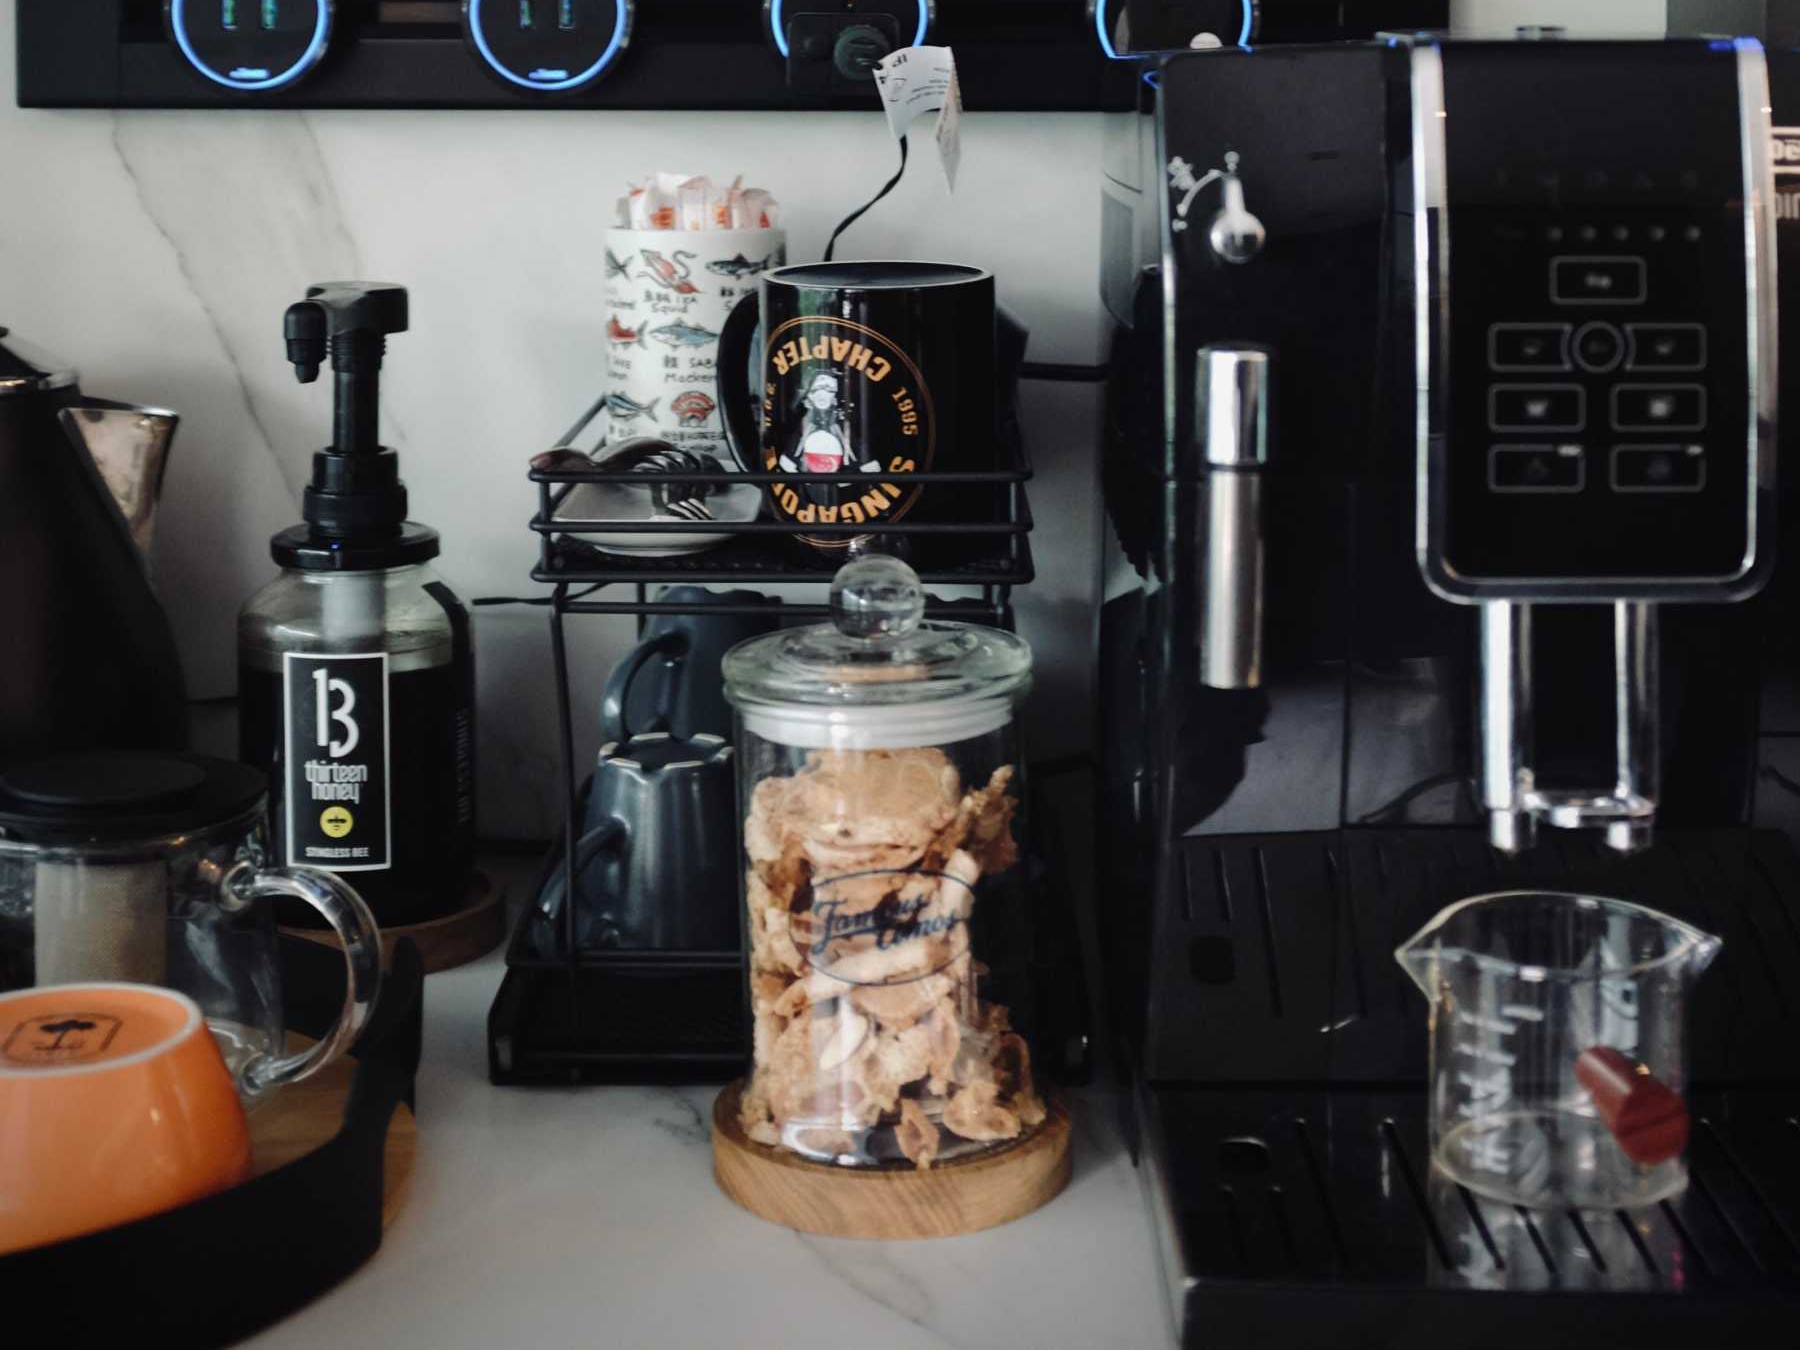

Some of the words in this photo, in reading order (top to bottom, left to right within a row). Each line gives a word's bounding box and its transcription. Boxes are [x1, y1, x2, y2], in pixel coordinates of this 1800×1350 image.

[689, 357, 719, 368] SAB
[772, 335, 892, 382] CHAPTER
[304, 759, 368, 783] thirteen
[312, 782, 359, 805] honey
